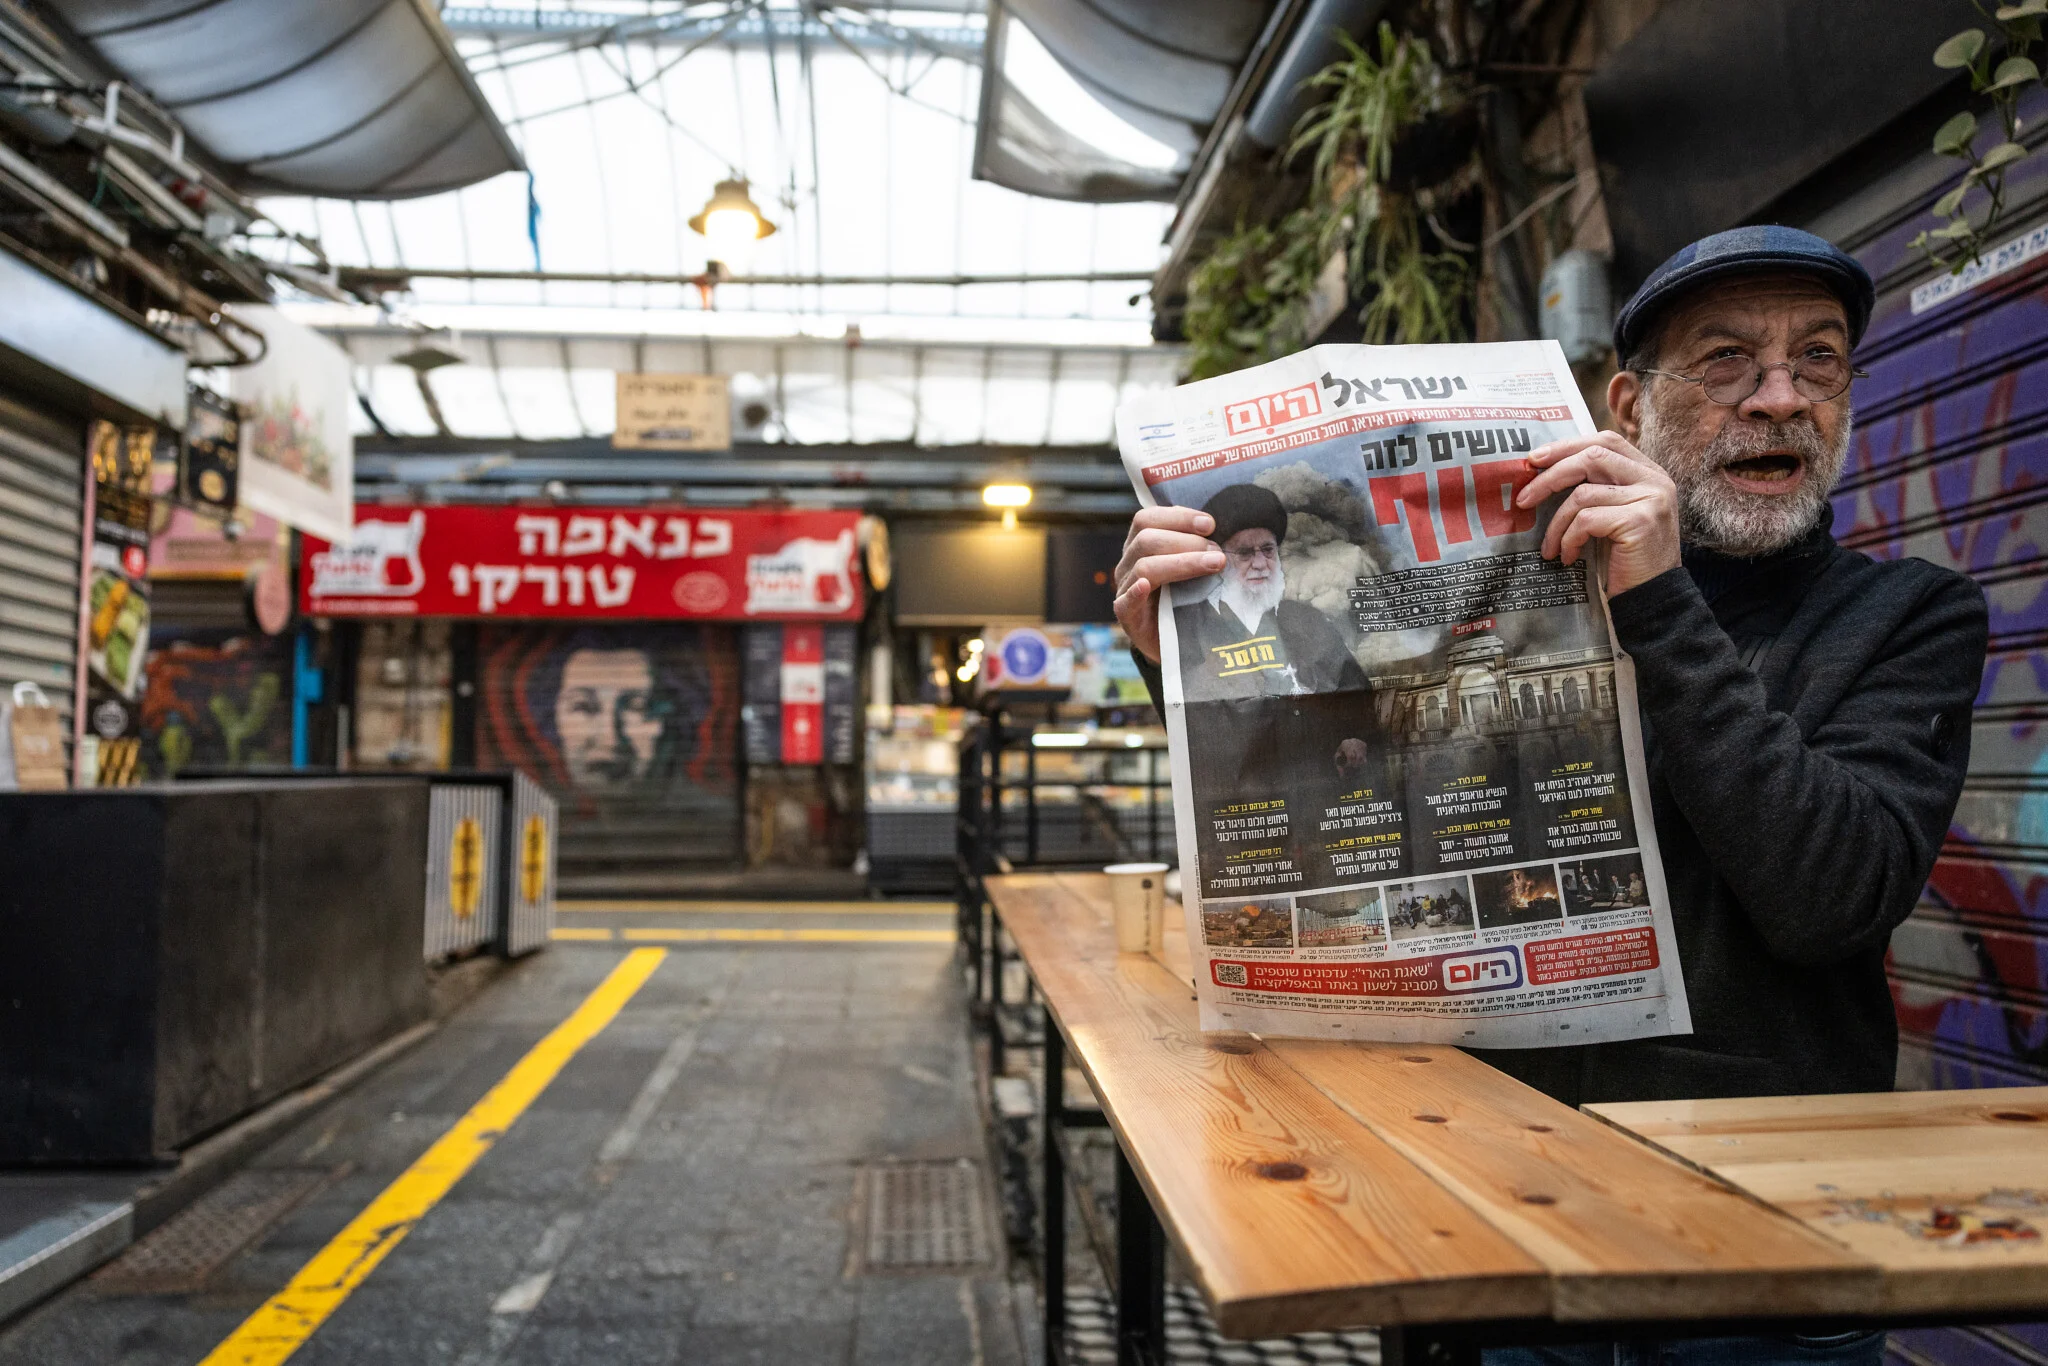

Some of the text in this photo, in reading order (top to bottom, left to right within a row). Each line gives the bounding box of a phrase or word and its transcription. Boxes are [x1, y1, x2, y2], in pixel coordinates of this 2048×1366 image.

[1321, 371, 1468, 408] ישראל
[1227, 387, 1320, 435] היום
[1387, 411, 1408, 424] רודן
[1412, 408, 1449, 420] חמינאי,
[1451, 408, 1471, 418] עלי
[1473, 408, 1504, 418] לאיש:
[1540, 408, 1564, 419] ככה
[1323, 420, 1349, 438] חוסל
[1351, 414, 1384, 433] איראן,
[1289, 428, 1320, 446] במכת
[1224, 449, 1239, 462] של
[1242, 437, 1287, 458] הפתיחה
[1360, 428, 1532, 470] עושים לזה
[1368, 458, 1538, 563] סוף
[516, 515, 733, 559] כנאפה
[449, 563, 636, 612] טורקי
[1219, 644, 1275, 668] חוסל
[1564, 763, 1580, 772] לימור
[1581, 761, 1593, 770] יואב
[1534, 772, 1616, 792] ישראל וארה"ב הניחו את
[1424, 786, 1508, 806] הנשיא טראמפ דילג מעל
[1538, 785, 1615, 803] התשתית לעם האיראני
[1325, 801, 1393, 818] טראמפ, הראשון מאז
[1435, 799, 1502, 817] המלכודת האיראנית
[1212, 813, 1289, 830] מימוש חלום מיגור ציר
[1319, 812, 1403, 831] צ'רצ'יל שפועל מול הרשע
[1548, 819, 1617, 837] טהרן מנסה לגרור את
[1266, 826, 1288, 837] הרשע
[1546, 830, 1622, 849] שכנותיה לעימות אזורי
[1438, 833, 1509, 851] אמונה ותעוזה יותר
[1329, 847, 1401, 866] רעידת אדמה: המהלך
[1438, 845, 1514, 863] מניהול סיכונים מחושב
[1225, 860, 1293, 876] אחרי חיסול חמינאי
[1335, 859, 1399, 877] של טראמפ ונתניהו
[1210, 871, 1303, 889] הדרמה האיראנית מתחילה
[1255, 962, 1433, 978] "שאגת הארי": עדכונים שוטפים
[1449, 959, 1511, 983] היום
[1254, 978, 1438, 993] מסביב לשעון באתר ובאפליקציה
